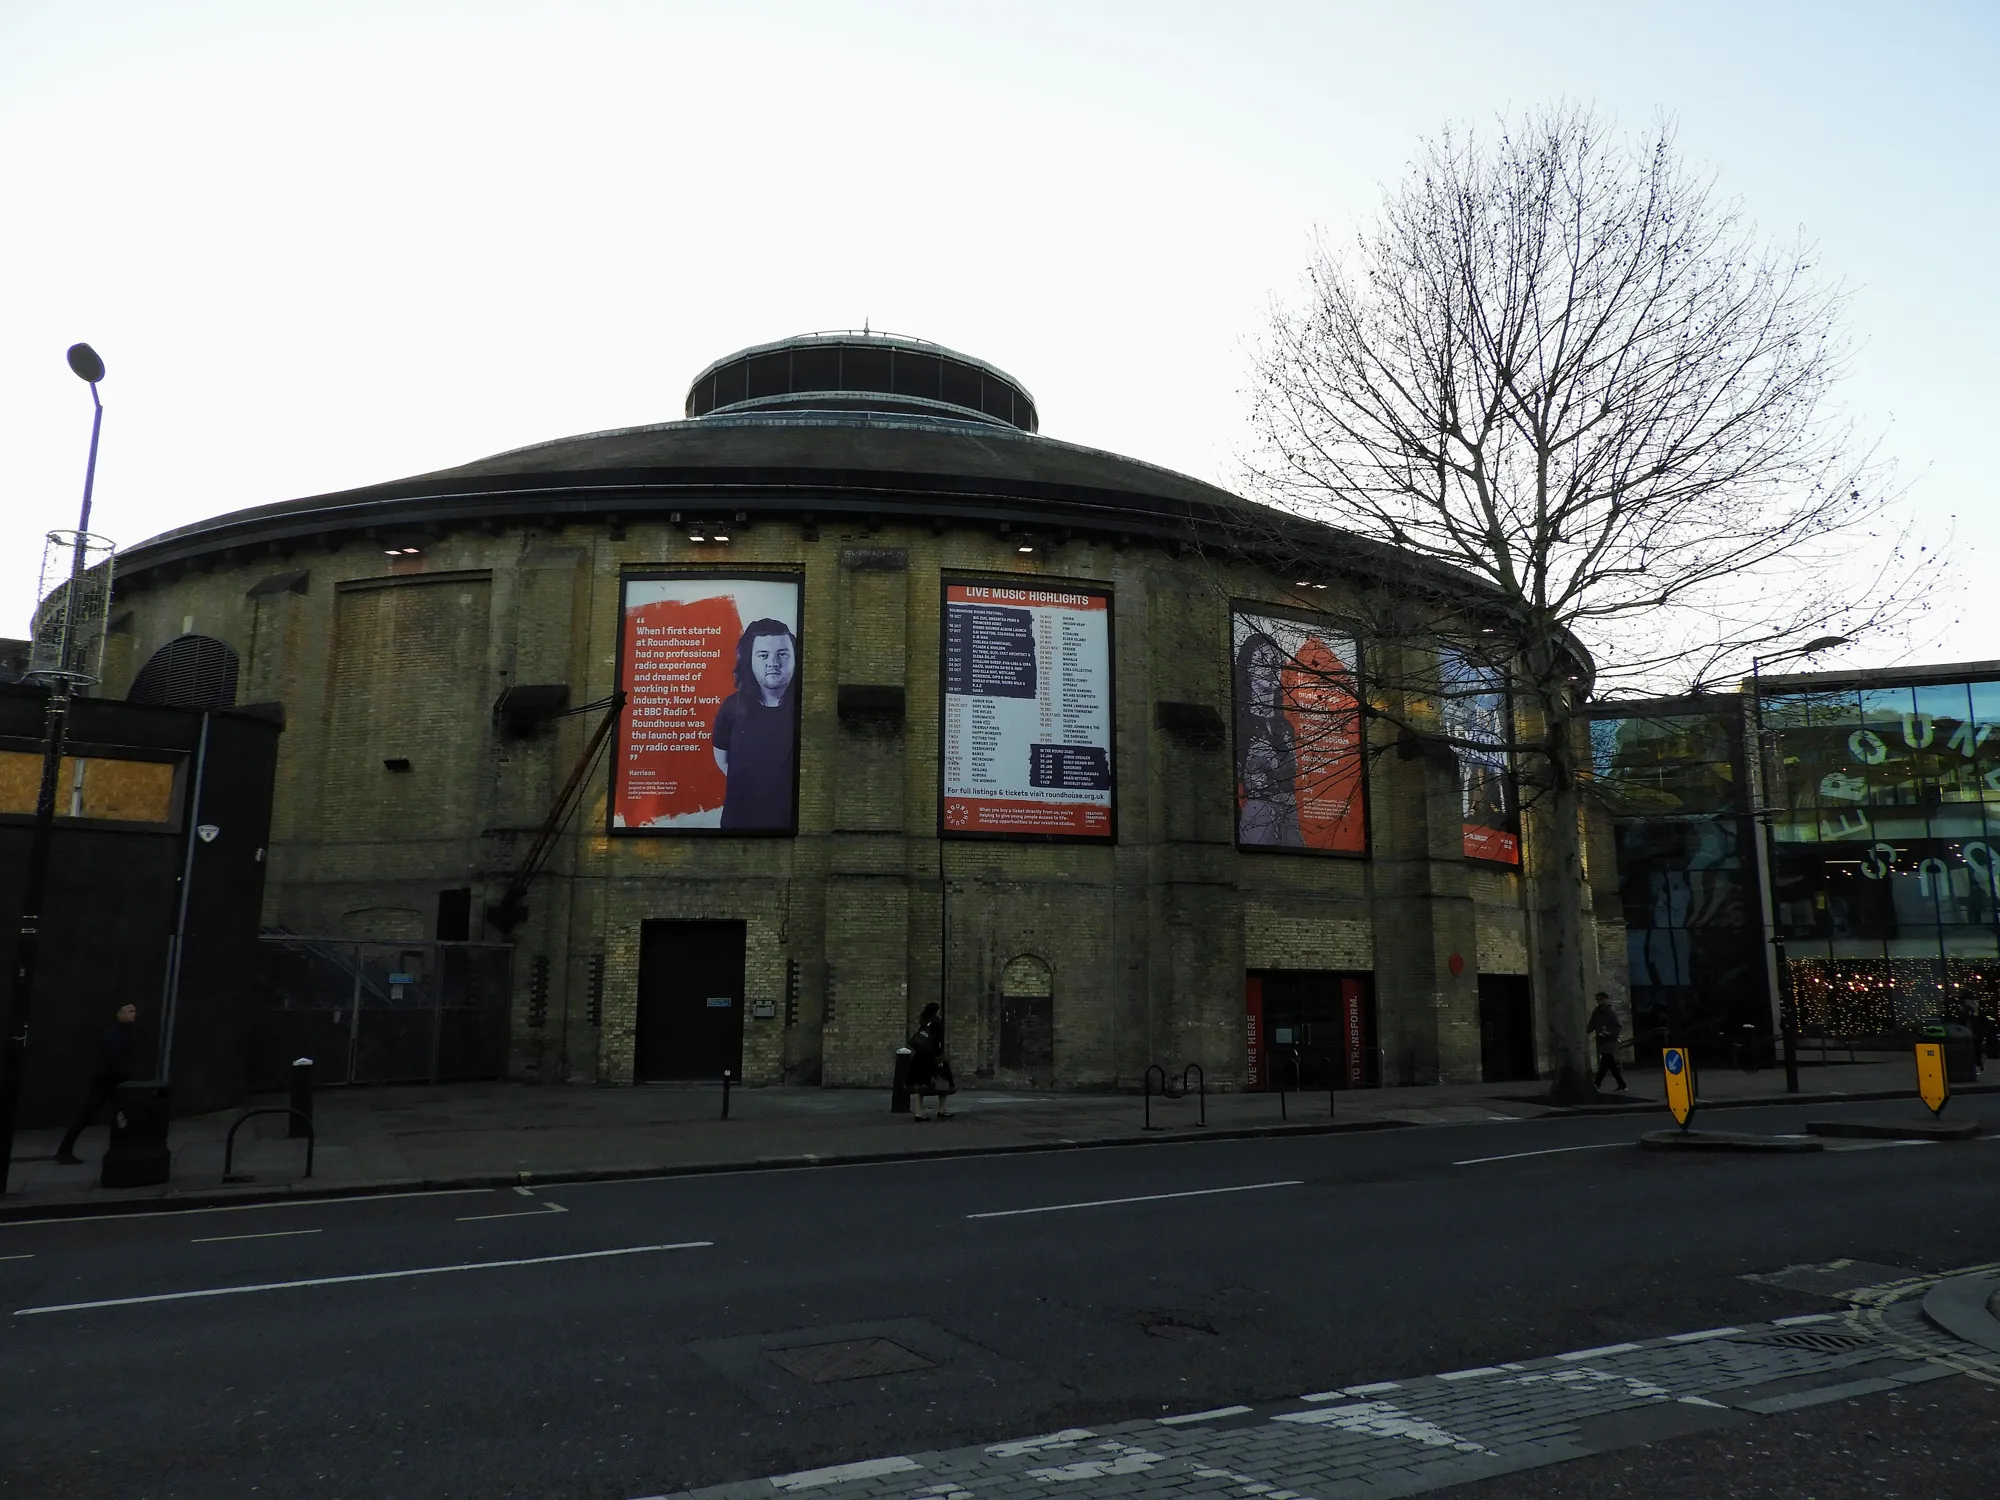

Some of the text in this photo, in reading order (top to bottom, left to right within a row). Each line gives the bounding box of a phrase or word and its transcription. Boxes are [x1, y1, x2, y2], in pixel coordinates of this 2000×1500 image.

[967, 587, 1089, 604] LIVE MUSIC HIGHLIGHTS
[636, 627, 660, 635] When
[688, 626, 721, 635] started
[648, 638, 700, 647] Roundhouse
[702, 638, 705, 646] I
[636, 650, 651, 658] had
[666, 649, 720, 660] professional
[659, 661, 707, 672] experience
[634, 673, 651, 681] and
[653, 672, 690, 681] dreamed
[634, 685, 668, 694] working
[633, 696, 672, 706] industry.
[674, 696, 692, 704] Now
[698, 696, 720, 704] work
[632, 719, 685, 728] Roundhouse
[632, 731, 711, 741] the launch pad for
[631, 744, 644, 753] my
[646, 743, 668, 751] radio
[973, 788, 997, 796] listings
[1046, 791, 1104, 800] roundhouse.org.uk
[947, 804, 969, 826] ROUNDHOUSE
[1247, 1014, 1258, 1085] WE'RE HERE
[1352, 1068, 1361, 1082] TO
